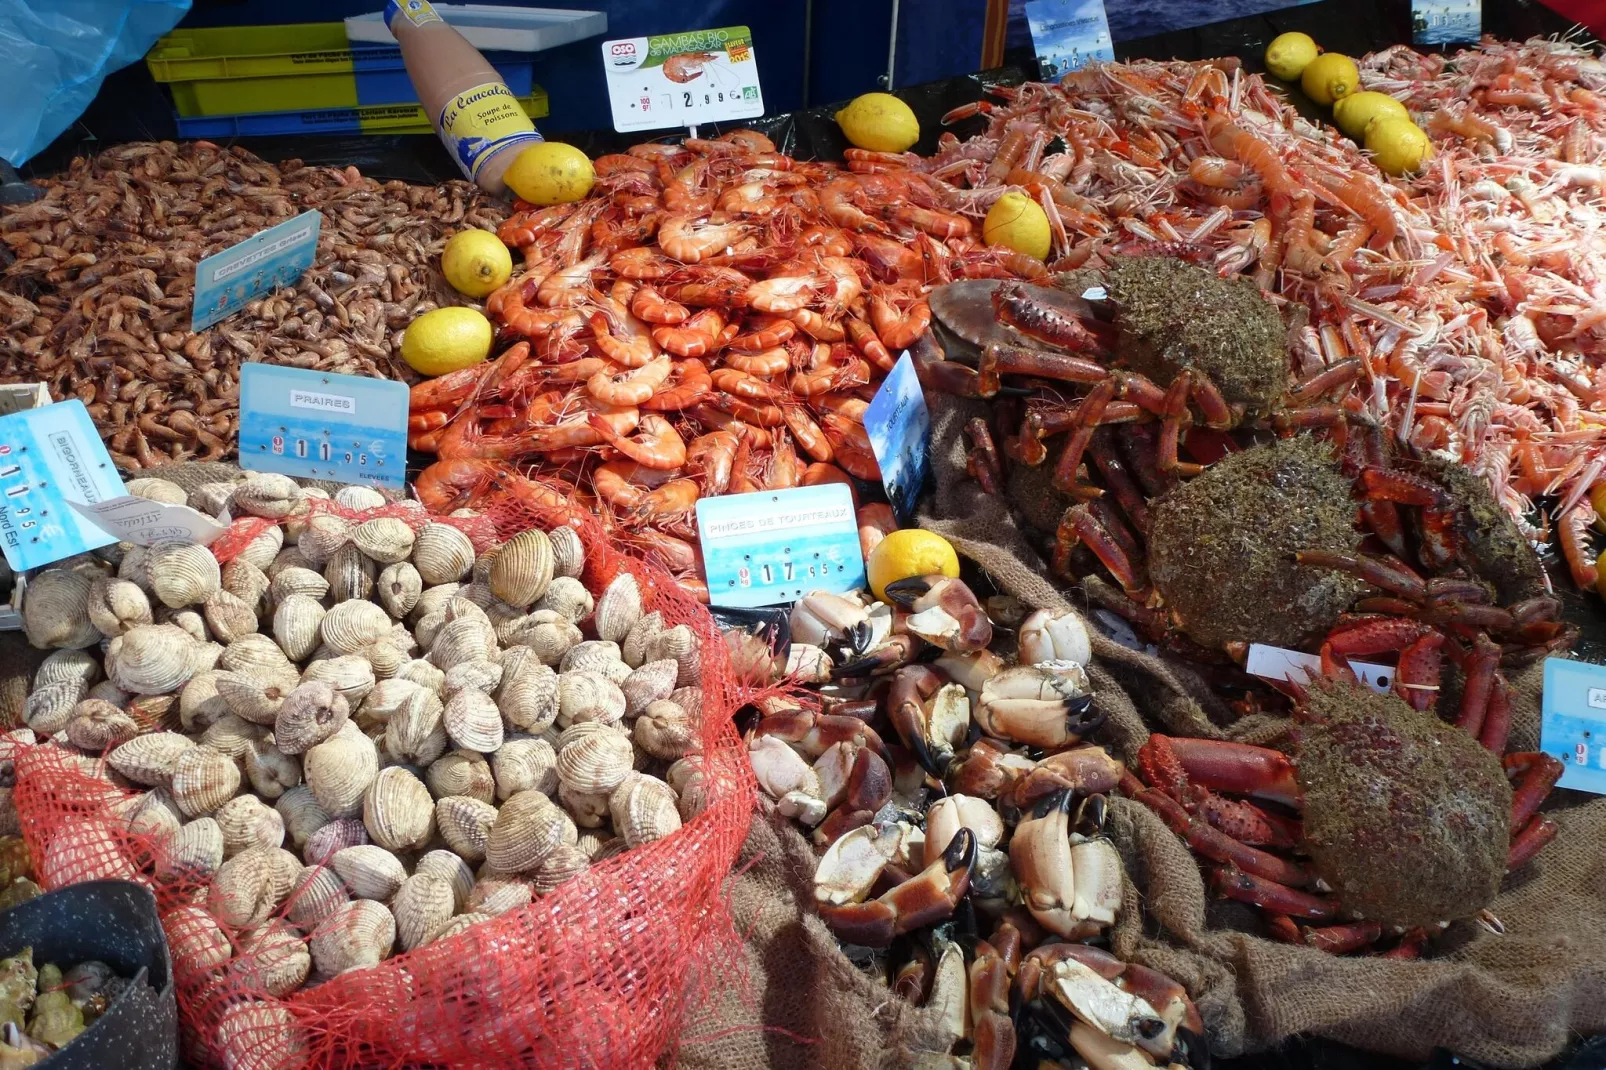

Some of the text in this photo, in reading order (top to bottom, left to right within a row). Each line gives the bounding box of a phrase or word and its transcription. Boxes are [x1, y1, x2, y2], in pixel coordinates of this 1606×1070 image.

[649, 30, 729, 50] GAMBAS BIO
[649, 48, 661, 57] de
[663, 41, 722, 55] MADAGASCAR
[729, 51, 752, 63] 2013
[477, 103, 512, 120] Soupe de
[484, 111, 519, 126] Poissons
[445, 110, 458, 131] La
[294, 394, 351, 409] PRAIRES
[886, 394, 909, 432] TOURTEAUX
[56, 435, 98, 505] BIGORNEAUX
[359, 472, 390, 482] ELEVEES
[0, 505, 21, 548] Nord Est
[710, 507, 849, 534] PINCES DE TOURTEAUX
[740, 578, 749, 586] kg
